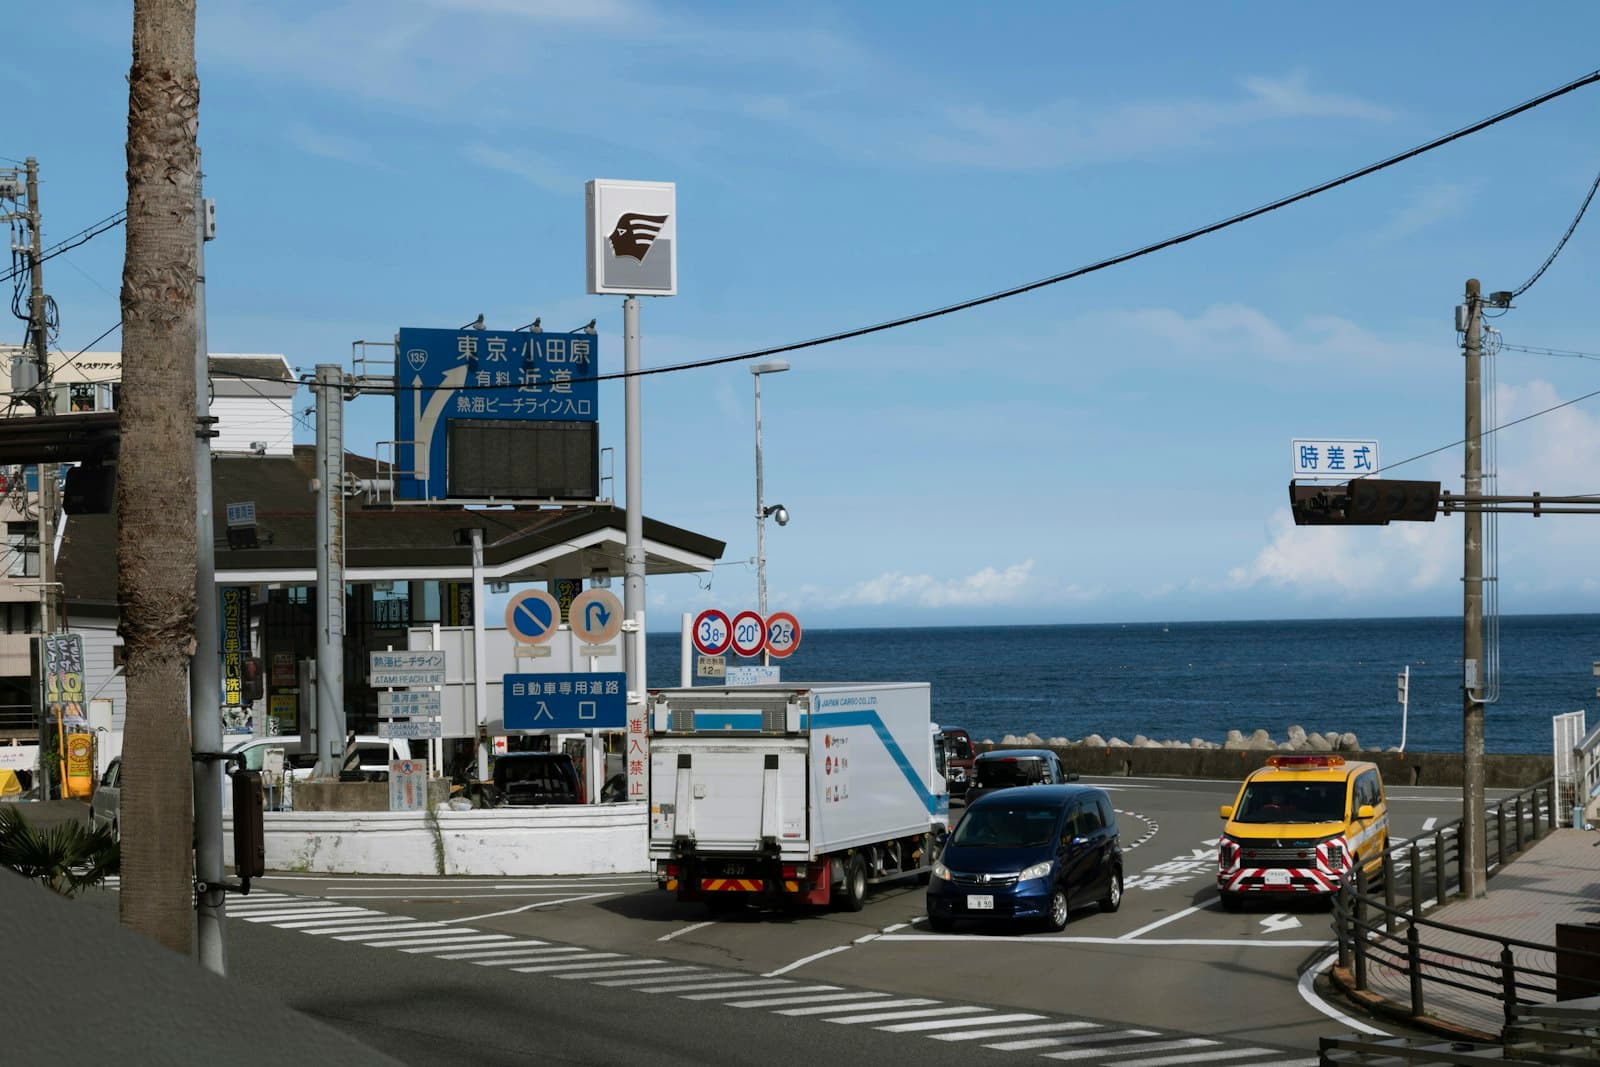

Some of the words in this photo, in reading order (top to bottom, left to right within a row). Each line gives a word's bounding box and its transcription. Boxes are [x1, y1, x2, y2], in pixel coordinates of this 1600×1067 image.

[410, 352, 424, 362] 135
[457, 335, 591, 364] 東京・小田原
[475, 370, 511, 388] 有料
[518, 367, 573, 394] 近道
[456, 397, 591, 415] 熱海ビーチライン入口
[1300, 445, 1371, 470] 時差式
[737, 623, 759, 642] 20t
[224, 590, 241, 706] サガミの手洗い洗車
[702, 666, 721, 675] 12m
[512, 681, 620, 696] 自動車専用道路
[629, 719, 643, 795] 進入禁止
